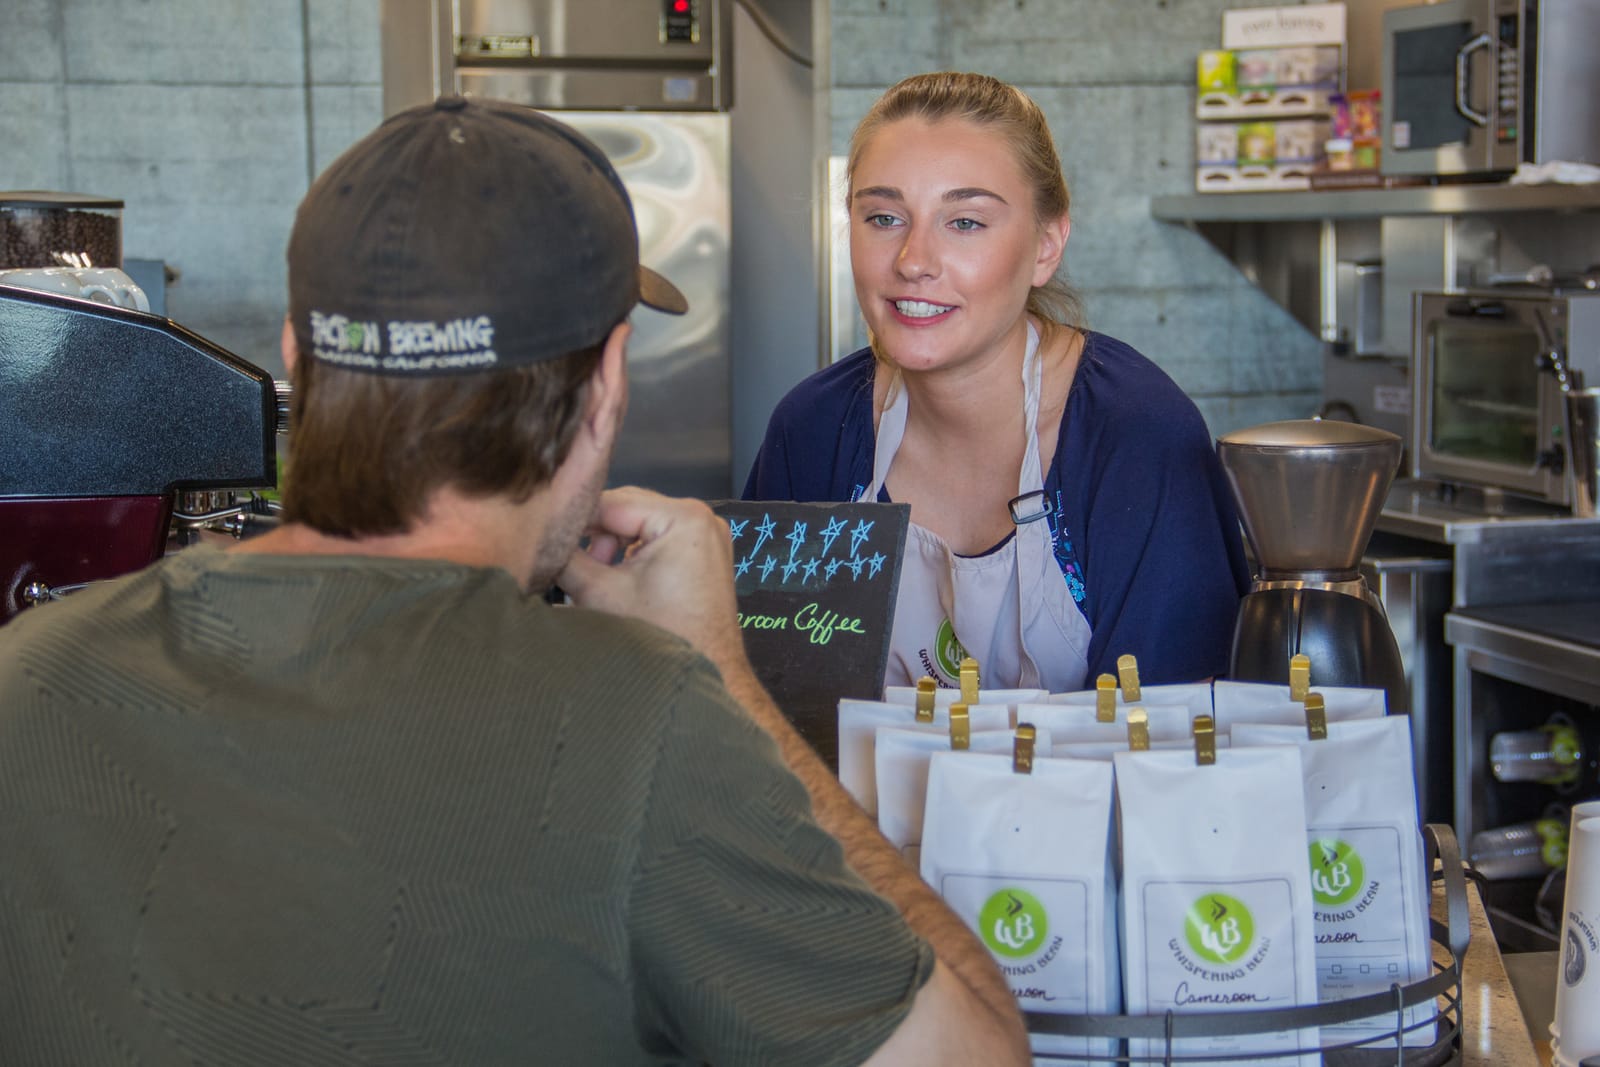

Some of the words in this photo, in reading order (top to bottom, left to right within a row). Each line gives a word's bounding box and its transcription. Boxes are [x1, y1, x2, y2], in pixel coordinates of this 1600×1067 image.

[388, 314, 495, 355] BREWING
[736, 611, 786, 630] eroon
[794, 603, 866, 645] Coffee
[1313, 909, 1357, 923] ERING
[1355, 880, 1380, 913] BEAN
[1036, 935, 1064, 968] BEAN
[1168, 937, 1246, 982] WHISPERING
[1245, 936, 1272, 972] BEAN
[1173, 981, 1271, 1006] Cameroon
